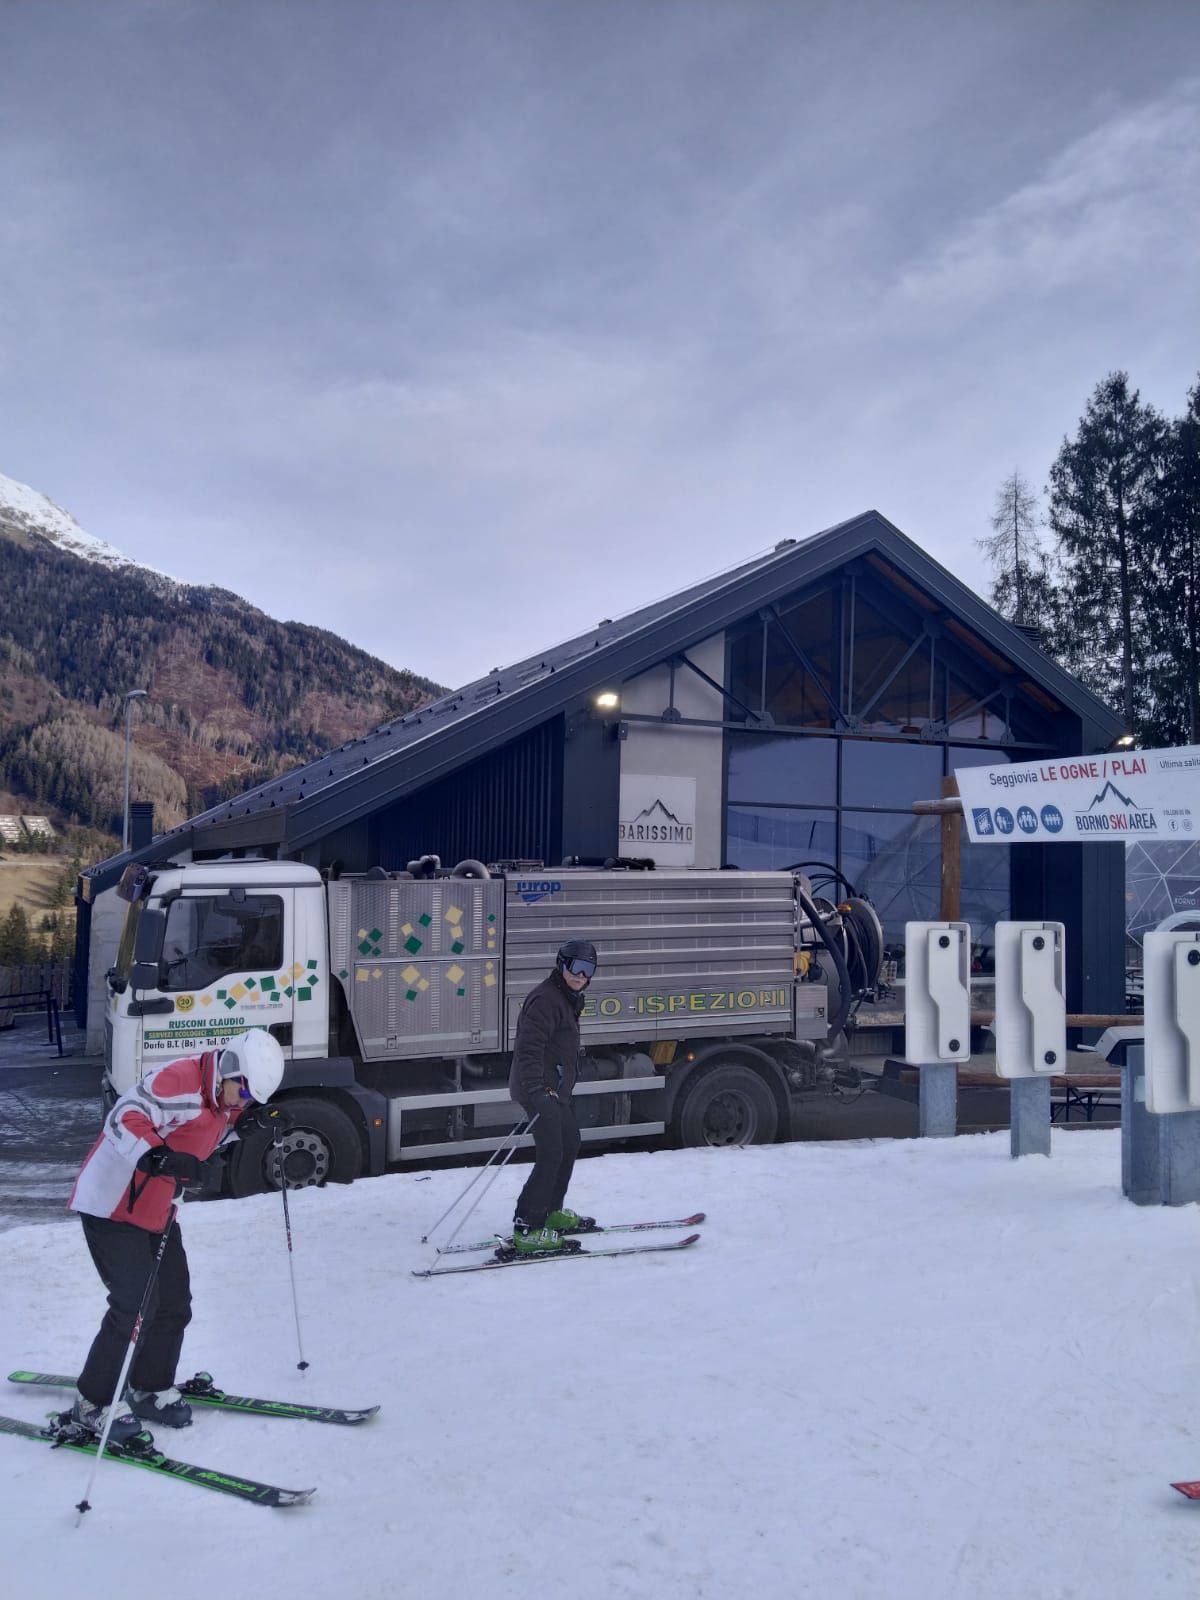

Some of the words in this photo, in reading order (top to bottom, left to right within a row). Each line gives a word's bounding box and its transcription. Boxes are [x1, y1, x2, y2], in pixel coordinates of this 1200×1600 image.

[989, 769, 1039, 788] Seggiovia
[1040, 766, 1057, 781] LE
[1060, 762, 1099, 780] OGNE
[1111, 757, 1147, 776] PLAI
[619, 824, 693, 841] BARISSIMO
[638, 989, 786, 1014] ISPEZIONI
[168, 1018, 206, 1029] RUSCONI
[208, 1016, 245, 1027] CLAUDIO
[175, 1029, 207, 1038] ECOLOGICI
[143, 1041, 165, 1050] Darfo
[181, 1039, 196, 1050] (Bs)
